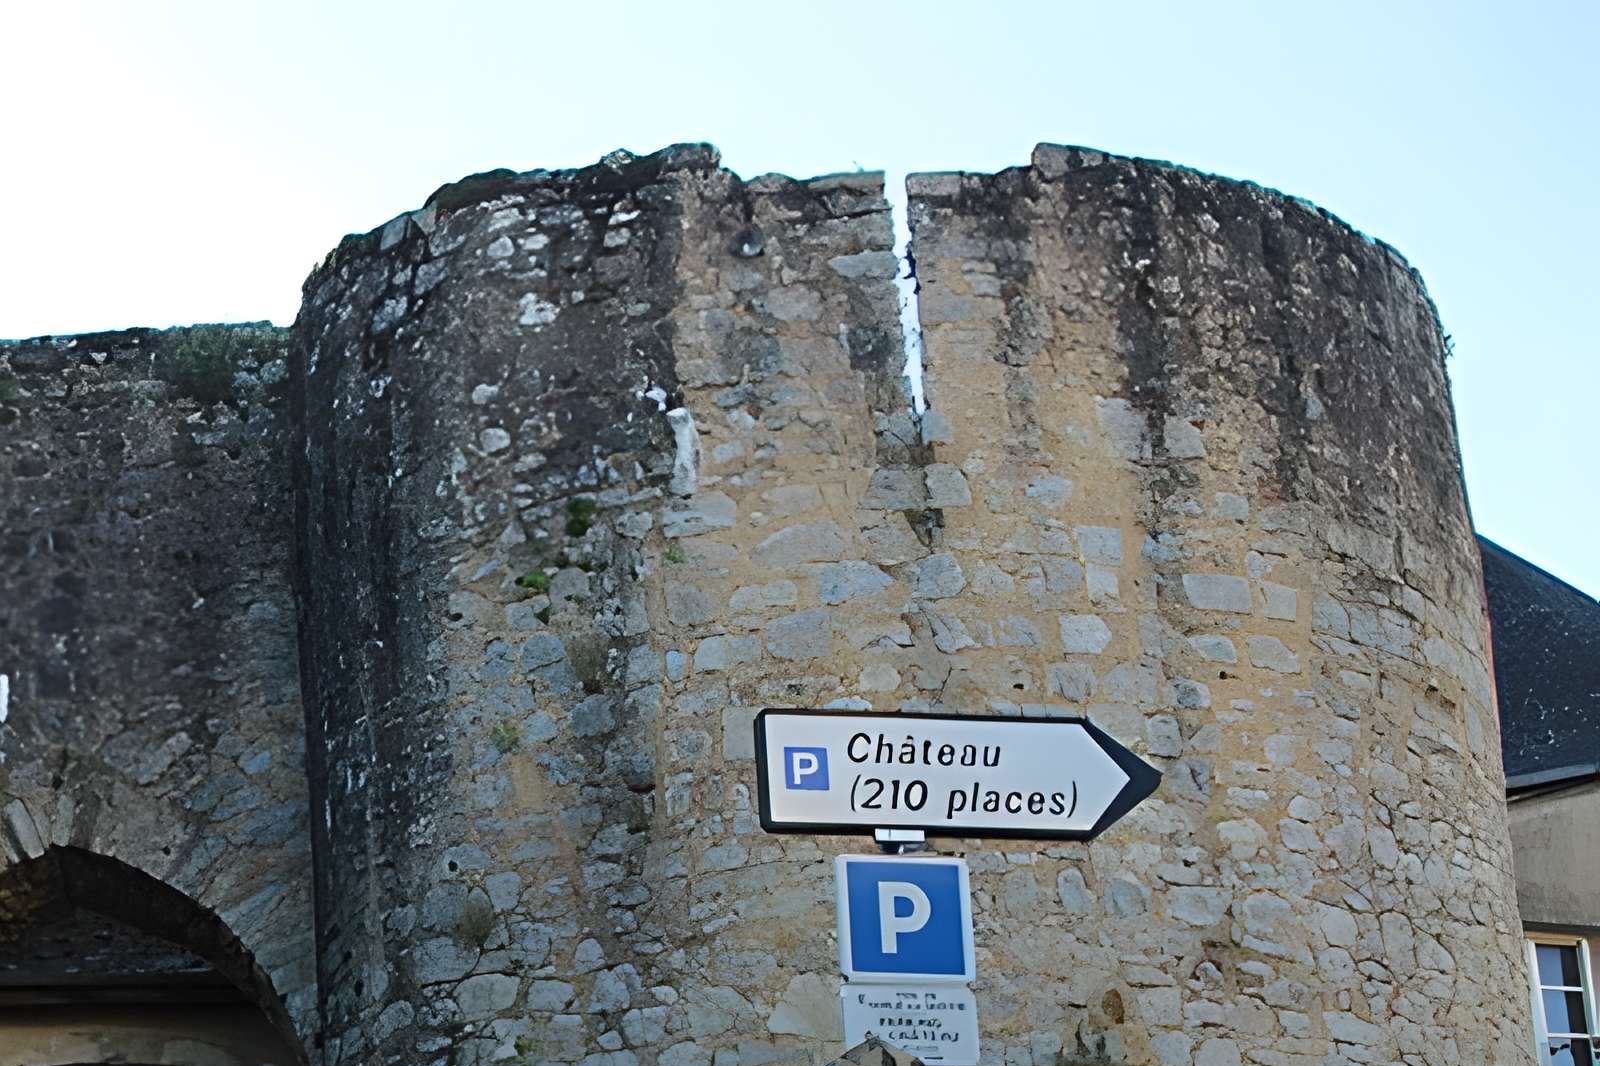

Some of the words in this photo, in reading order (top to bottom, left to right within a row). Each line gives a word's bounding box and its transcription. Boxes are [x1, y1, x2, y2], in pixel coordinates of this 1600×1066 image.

[792, 752, 819, 785] P
[847, 732, 1001, 768] Château
[850, 774, 929, 812] (210
[946, 780, 1078, 820] places)
[877, 880, 932, 955] P
